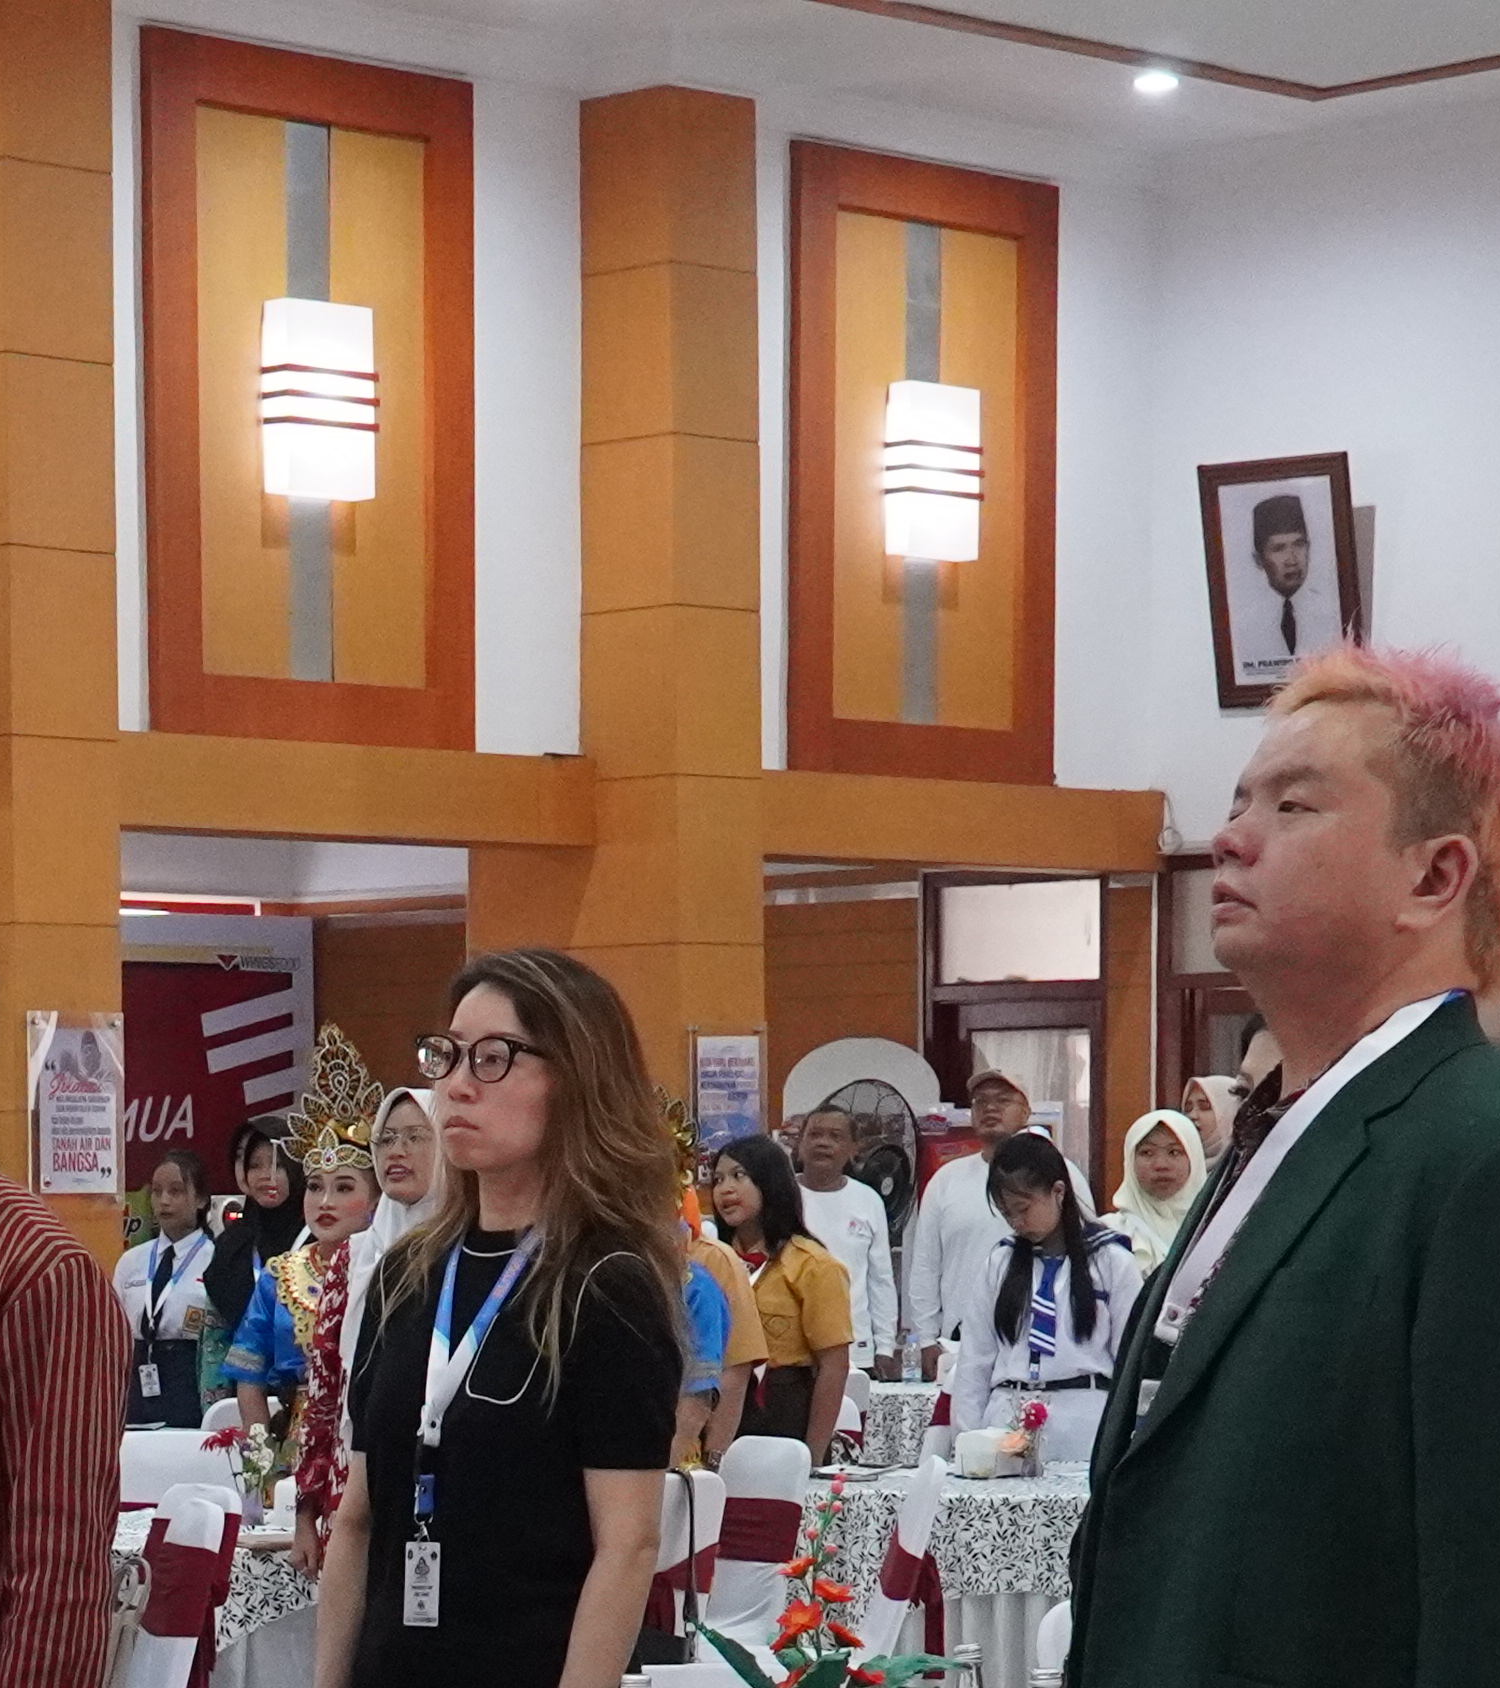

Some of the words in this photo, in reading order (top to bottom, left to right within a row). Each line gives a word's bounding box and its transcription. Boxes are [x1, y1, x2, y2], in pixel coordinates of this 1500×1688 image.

[80, 1137, 93, 1150] AIR
[94, 1137, 111, 1150] DAN
[53, 1151, 99, 1173] BANGSA
